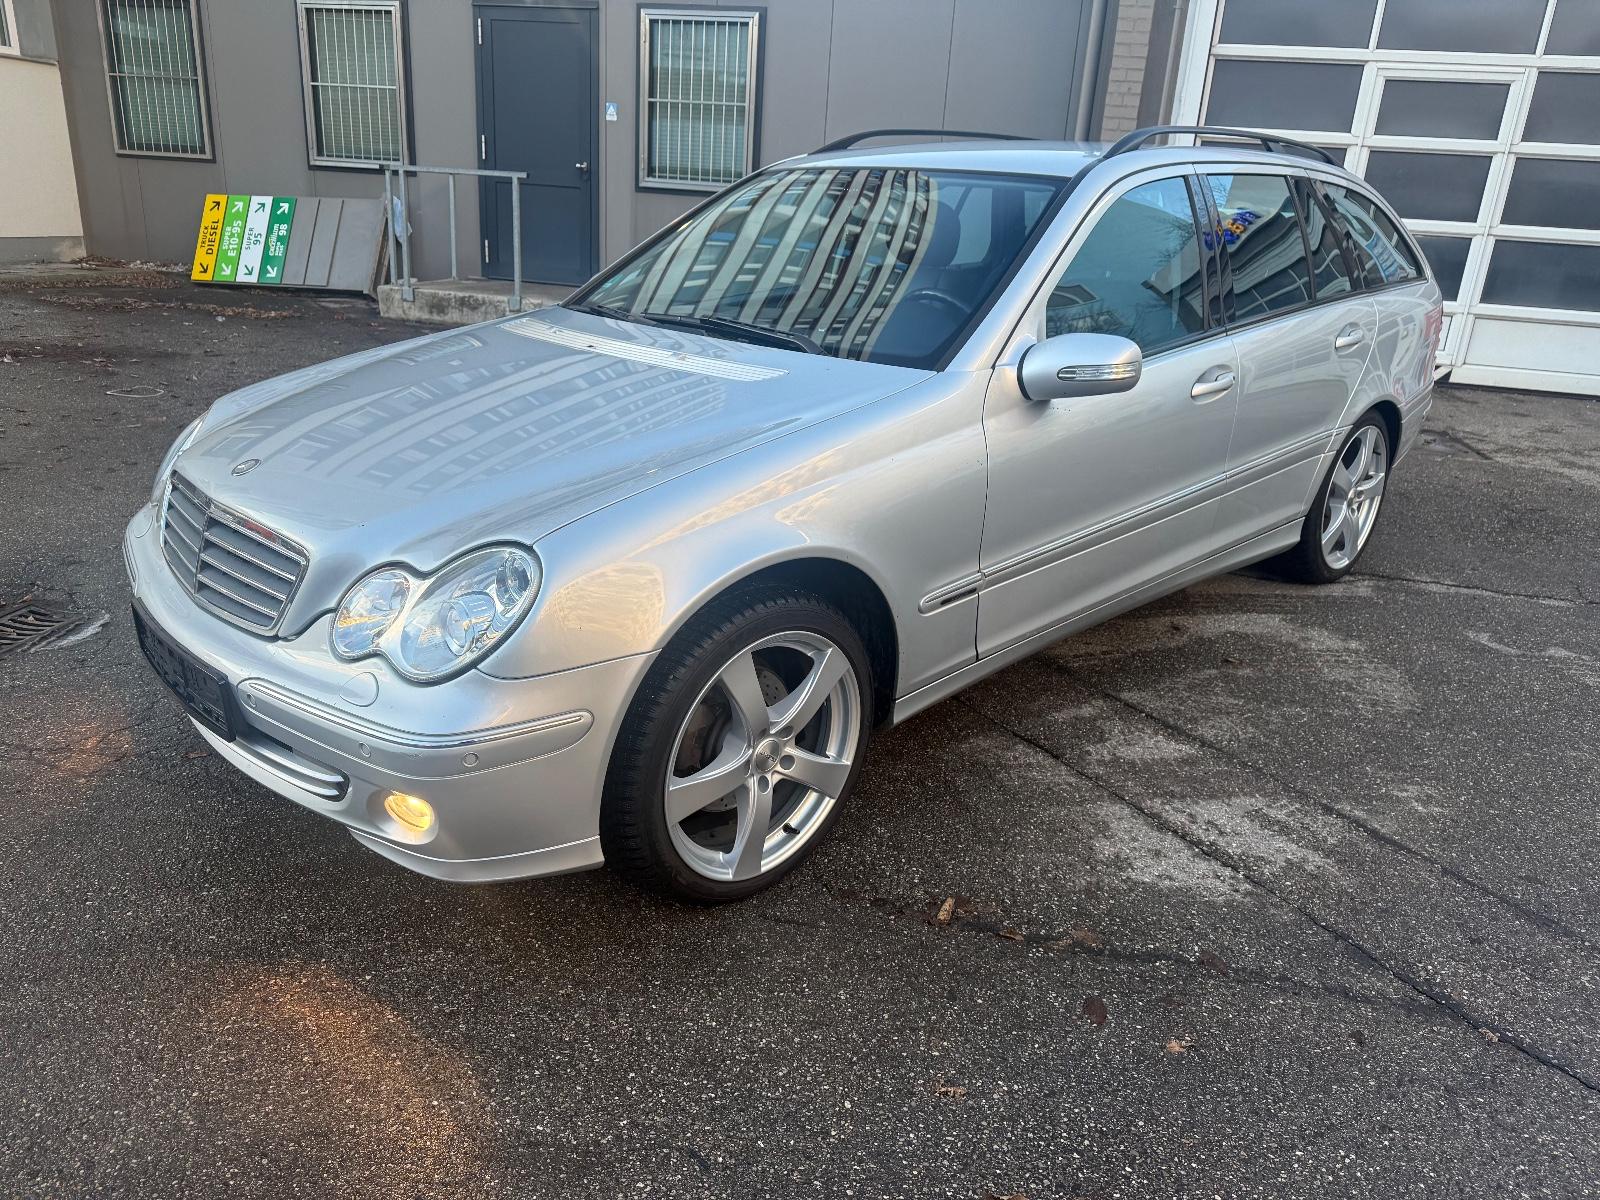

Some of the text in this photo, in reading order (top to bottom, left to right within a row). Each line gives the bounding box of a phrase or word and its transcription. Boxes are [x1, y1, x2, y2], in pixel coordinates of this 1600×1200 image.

[200, 225, 209, 248] TRUCK
[206, 219, 219, 254] DIESEL
[222, 227, 232, 250] SUPER
[228, 220, 242, 256] E10-95
[245, 227, 254, 250] SUPER
[253, 233, 262, 246] 95
[278, 224, 287, 236] 98
